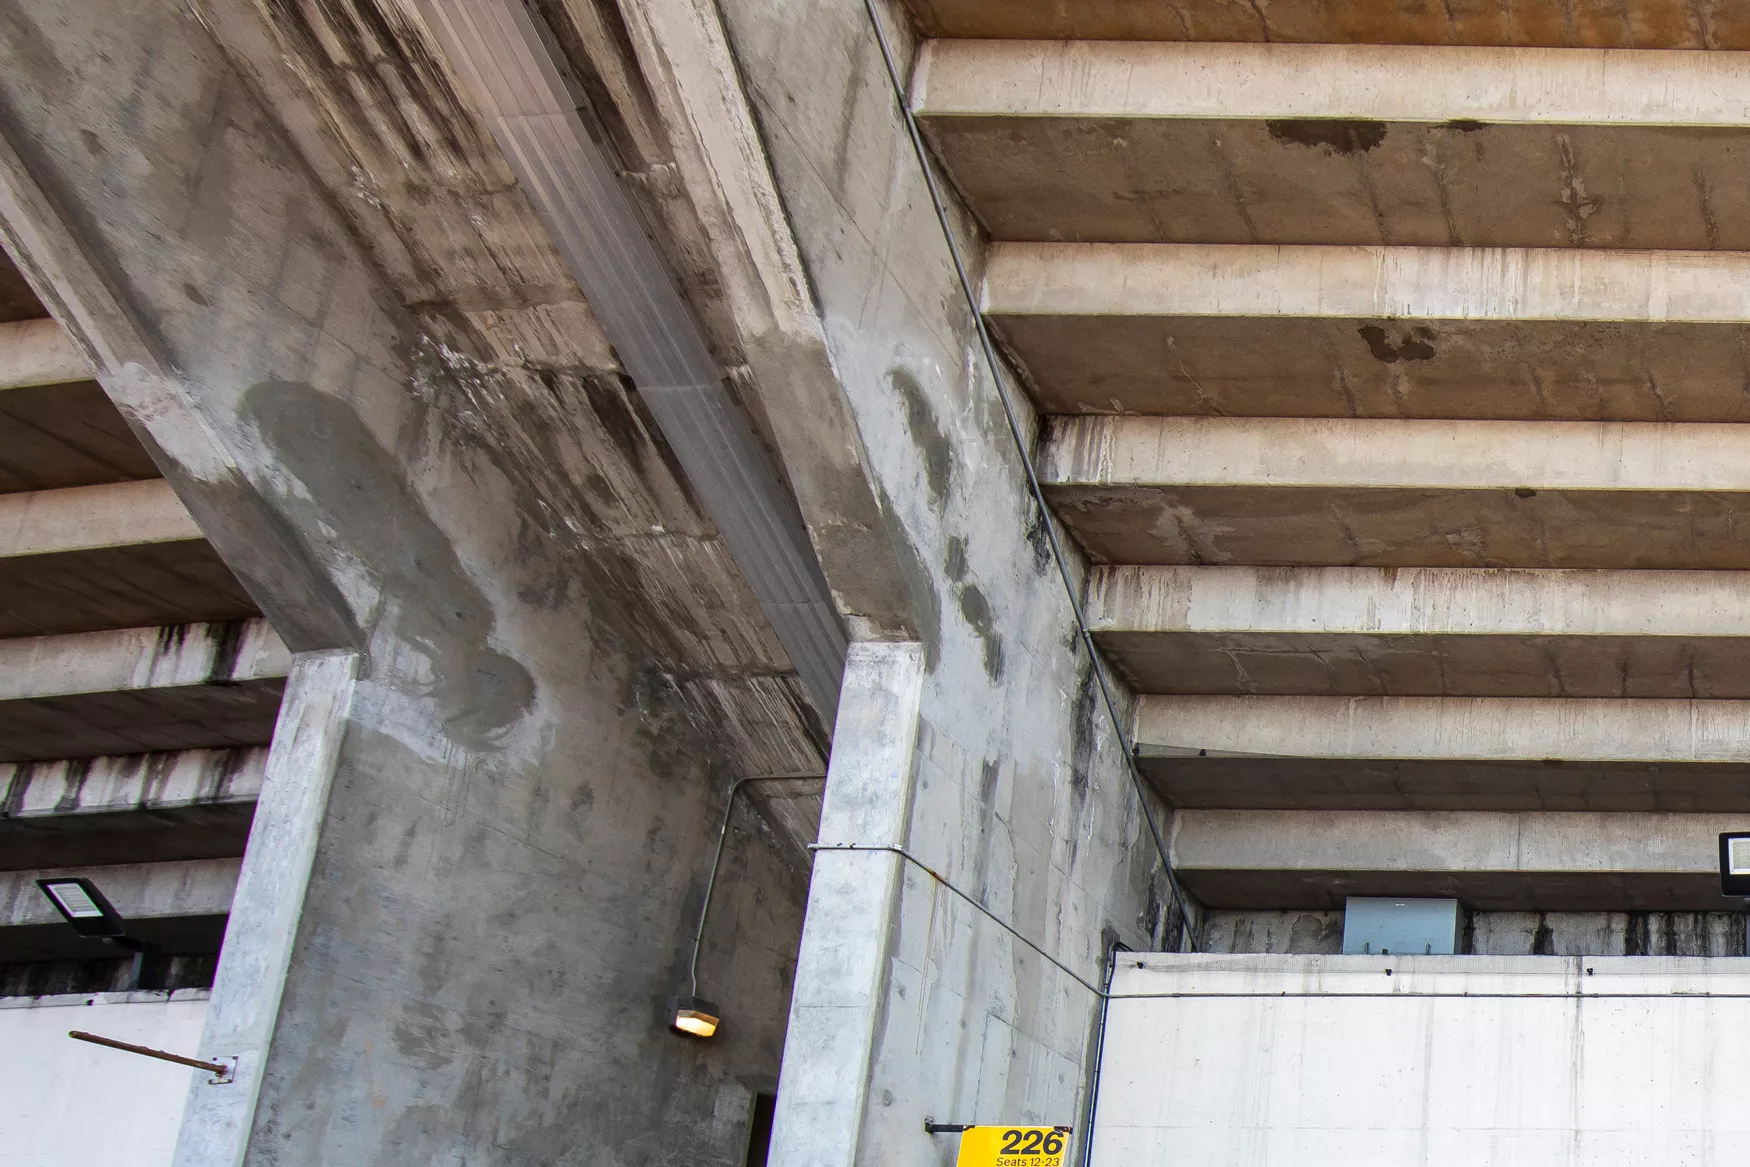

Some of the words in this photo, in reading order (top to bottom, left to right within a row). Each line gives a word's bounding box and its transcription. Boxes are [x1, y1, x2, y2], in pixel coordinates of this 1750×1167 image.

[1000, 1129, 1064, 1155] 226
[996, 1157, 1027, 1167] Seats
[1030, 1157, 1060, 1167] 12-23
